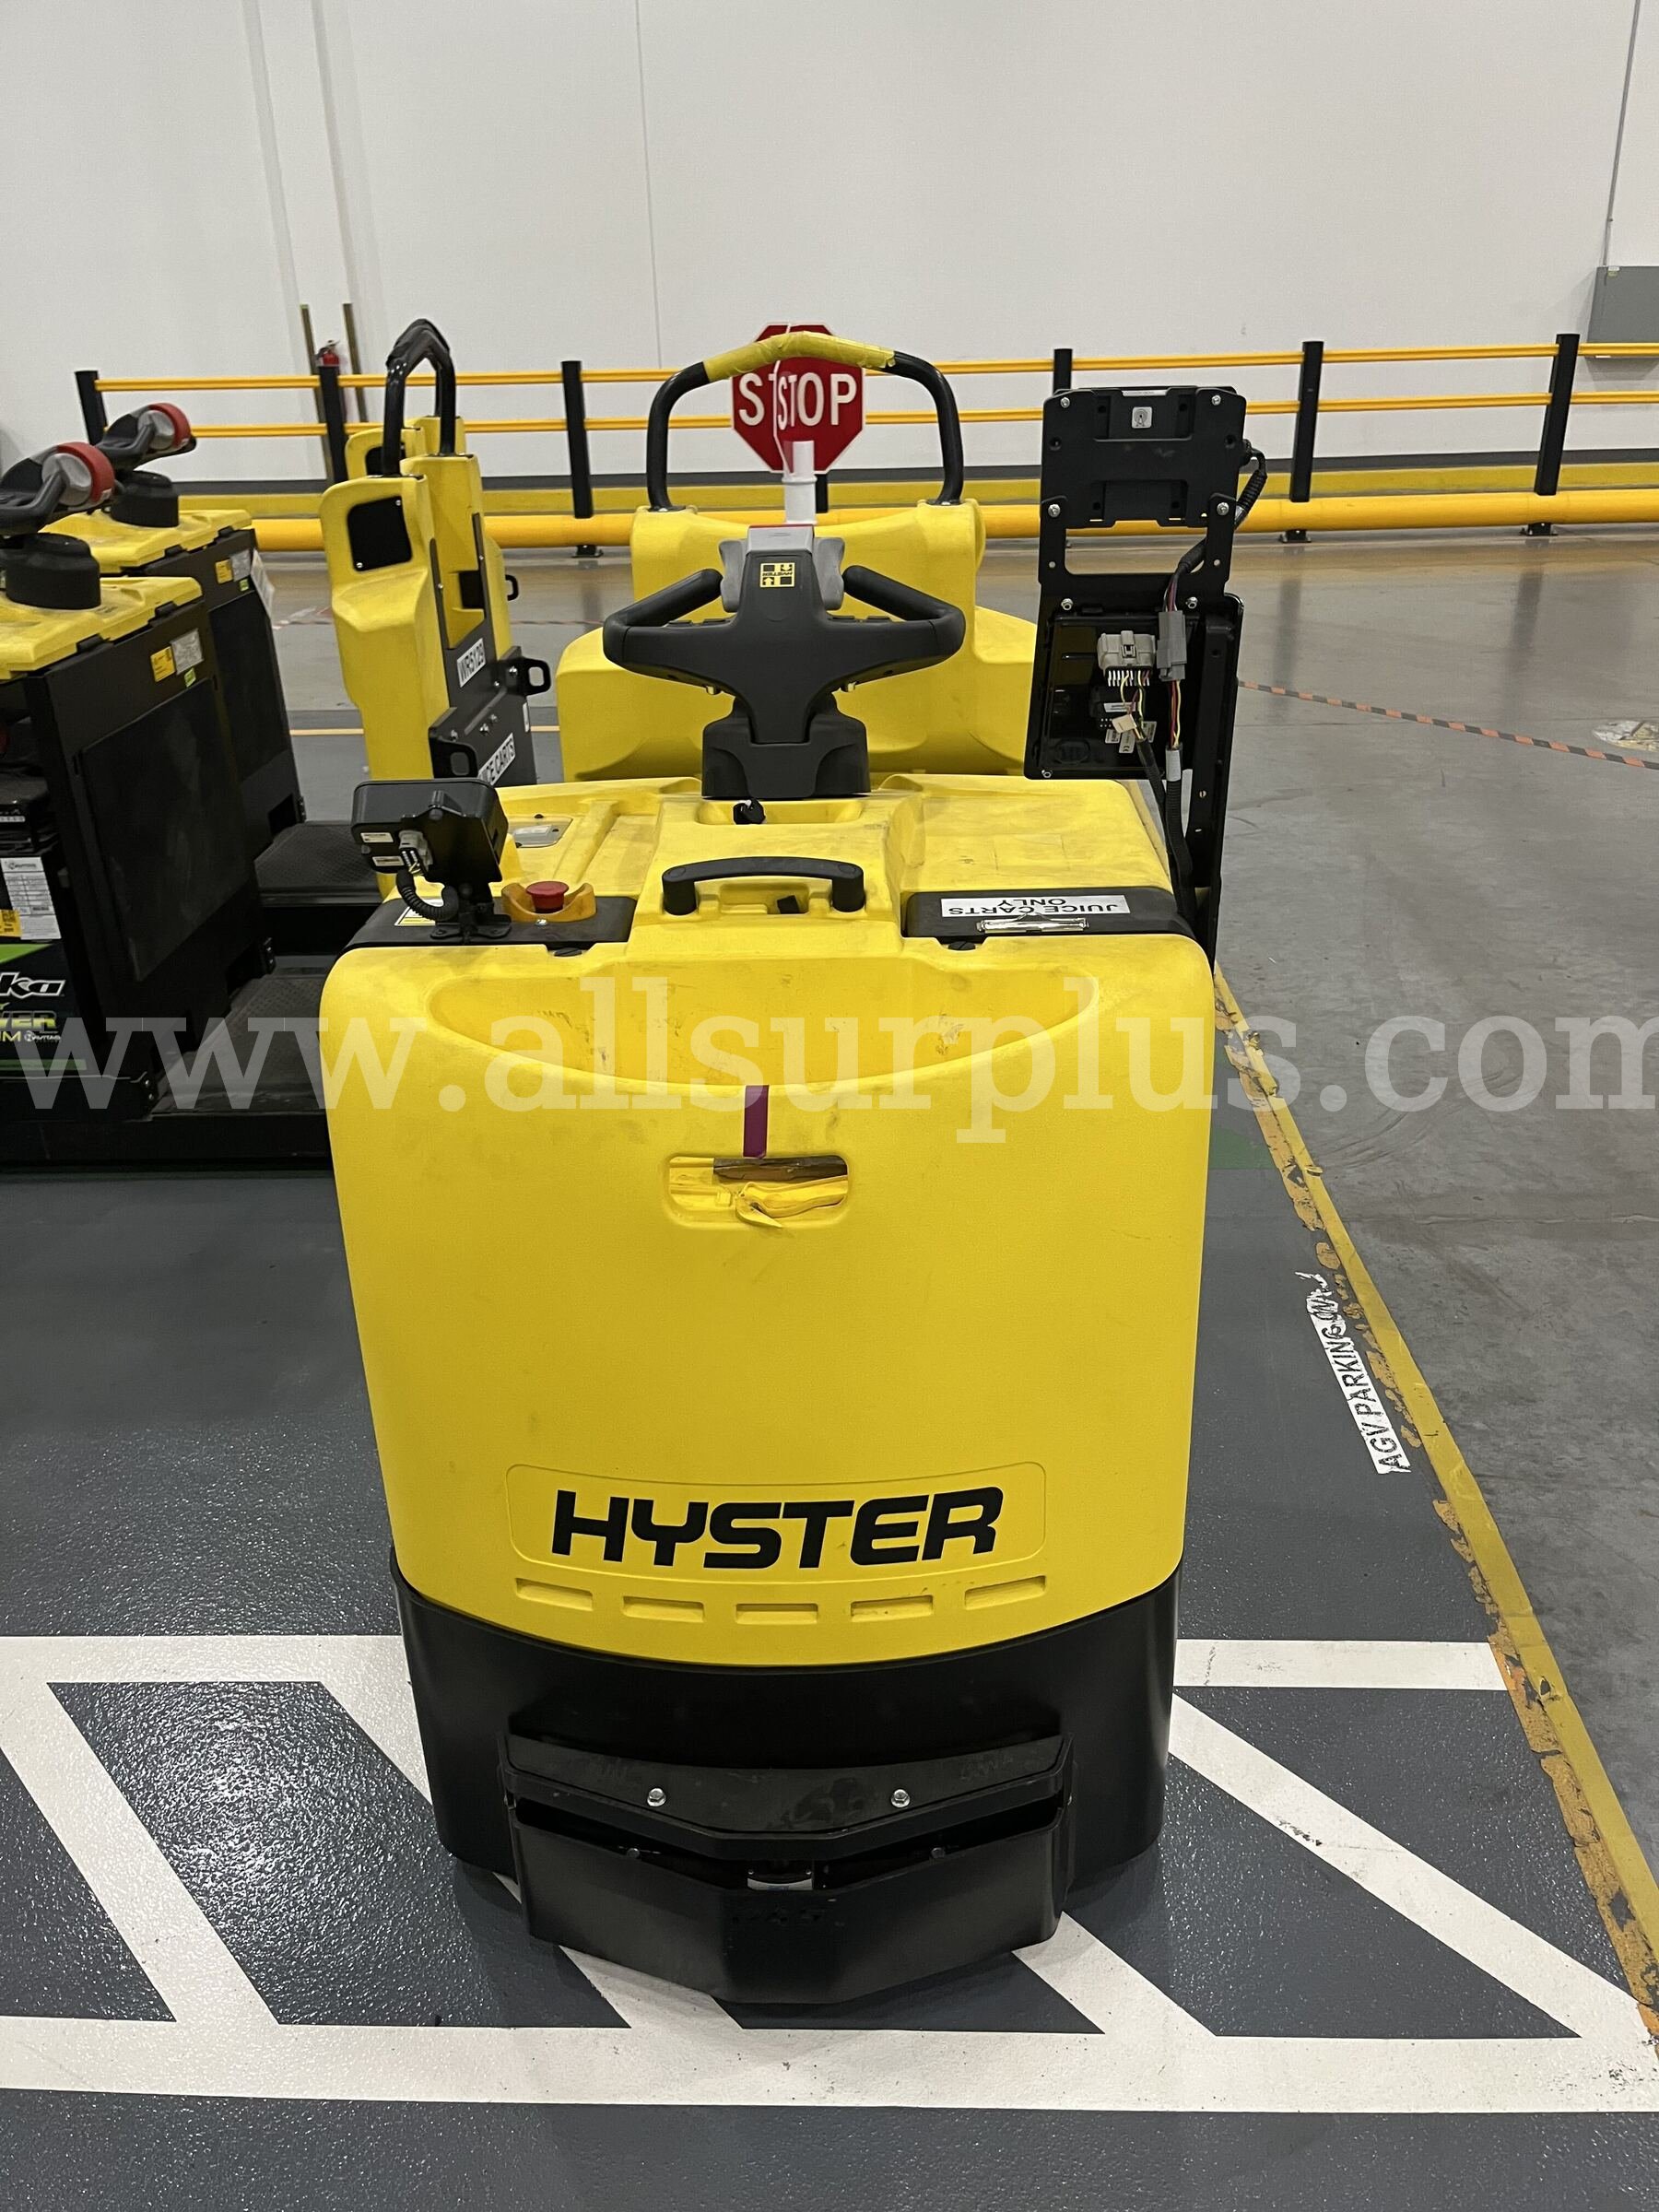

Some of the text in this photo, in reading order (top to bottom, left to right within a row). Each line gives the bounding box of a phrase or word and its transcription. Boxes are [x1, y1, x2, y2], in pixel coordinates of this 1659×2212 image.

[778, 371, 857, 430] STOP
[948, 903, 1118, 916] JUICE CARTS
[998, 899, 1066, 908] ONLY
[1321, 1324, 1384, 1416] PARKING
[1361, 1421, 1411, 1471] AGV
[551, 1487, 1004, 1569] HYSTER
